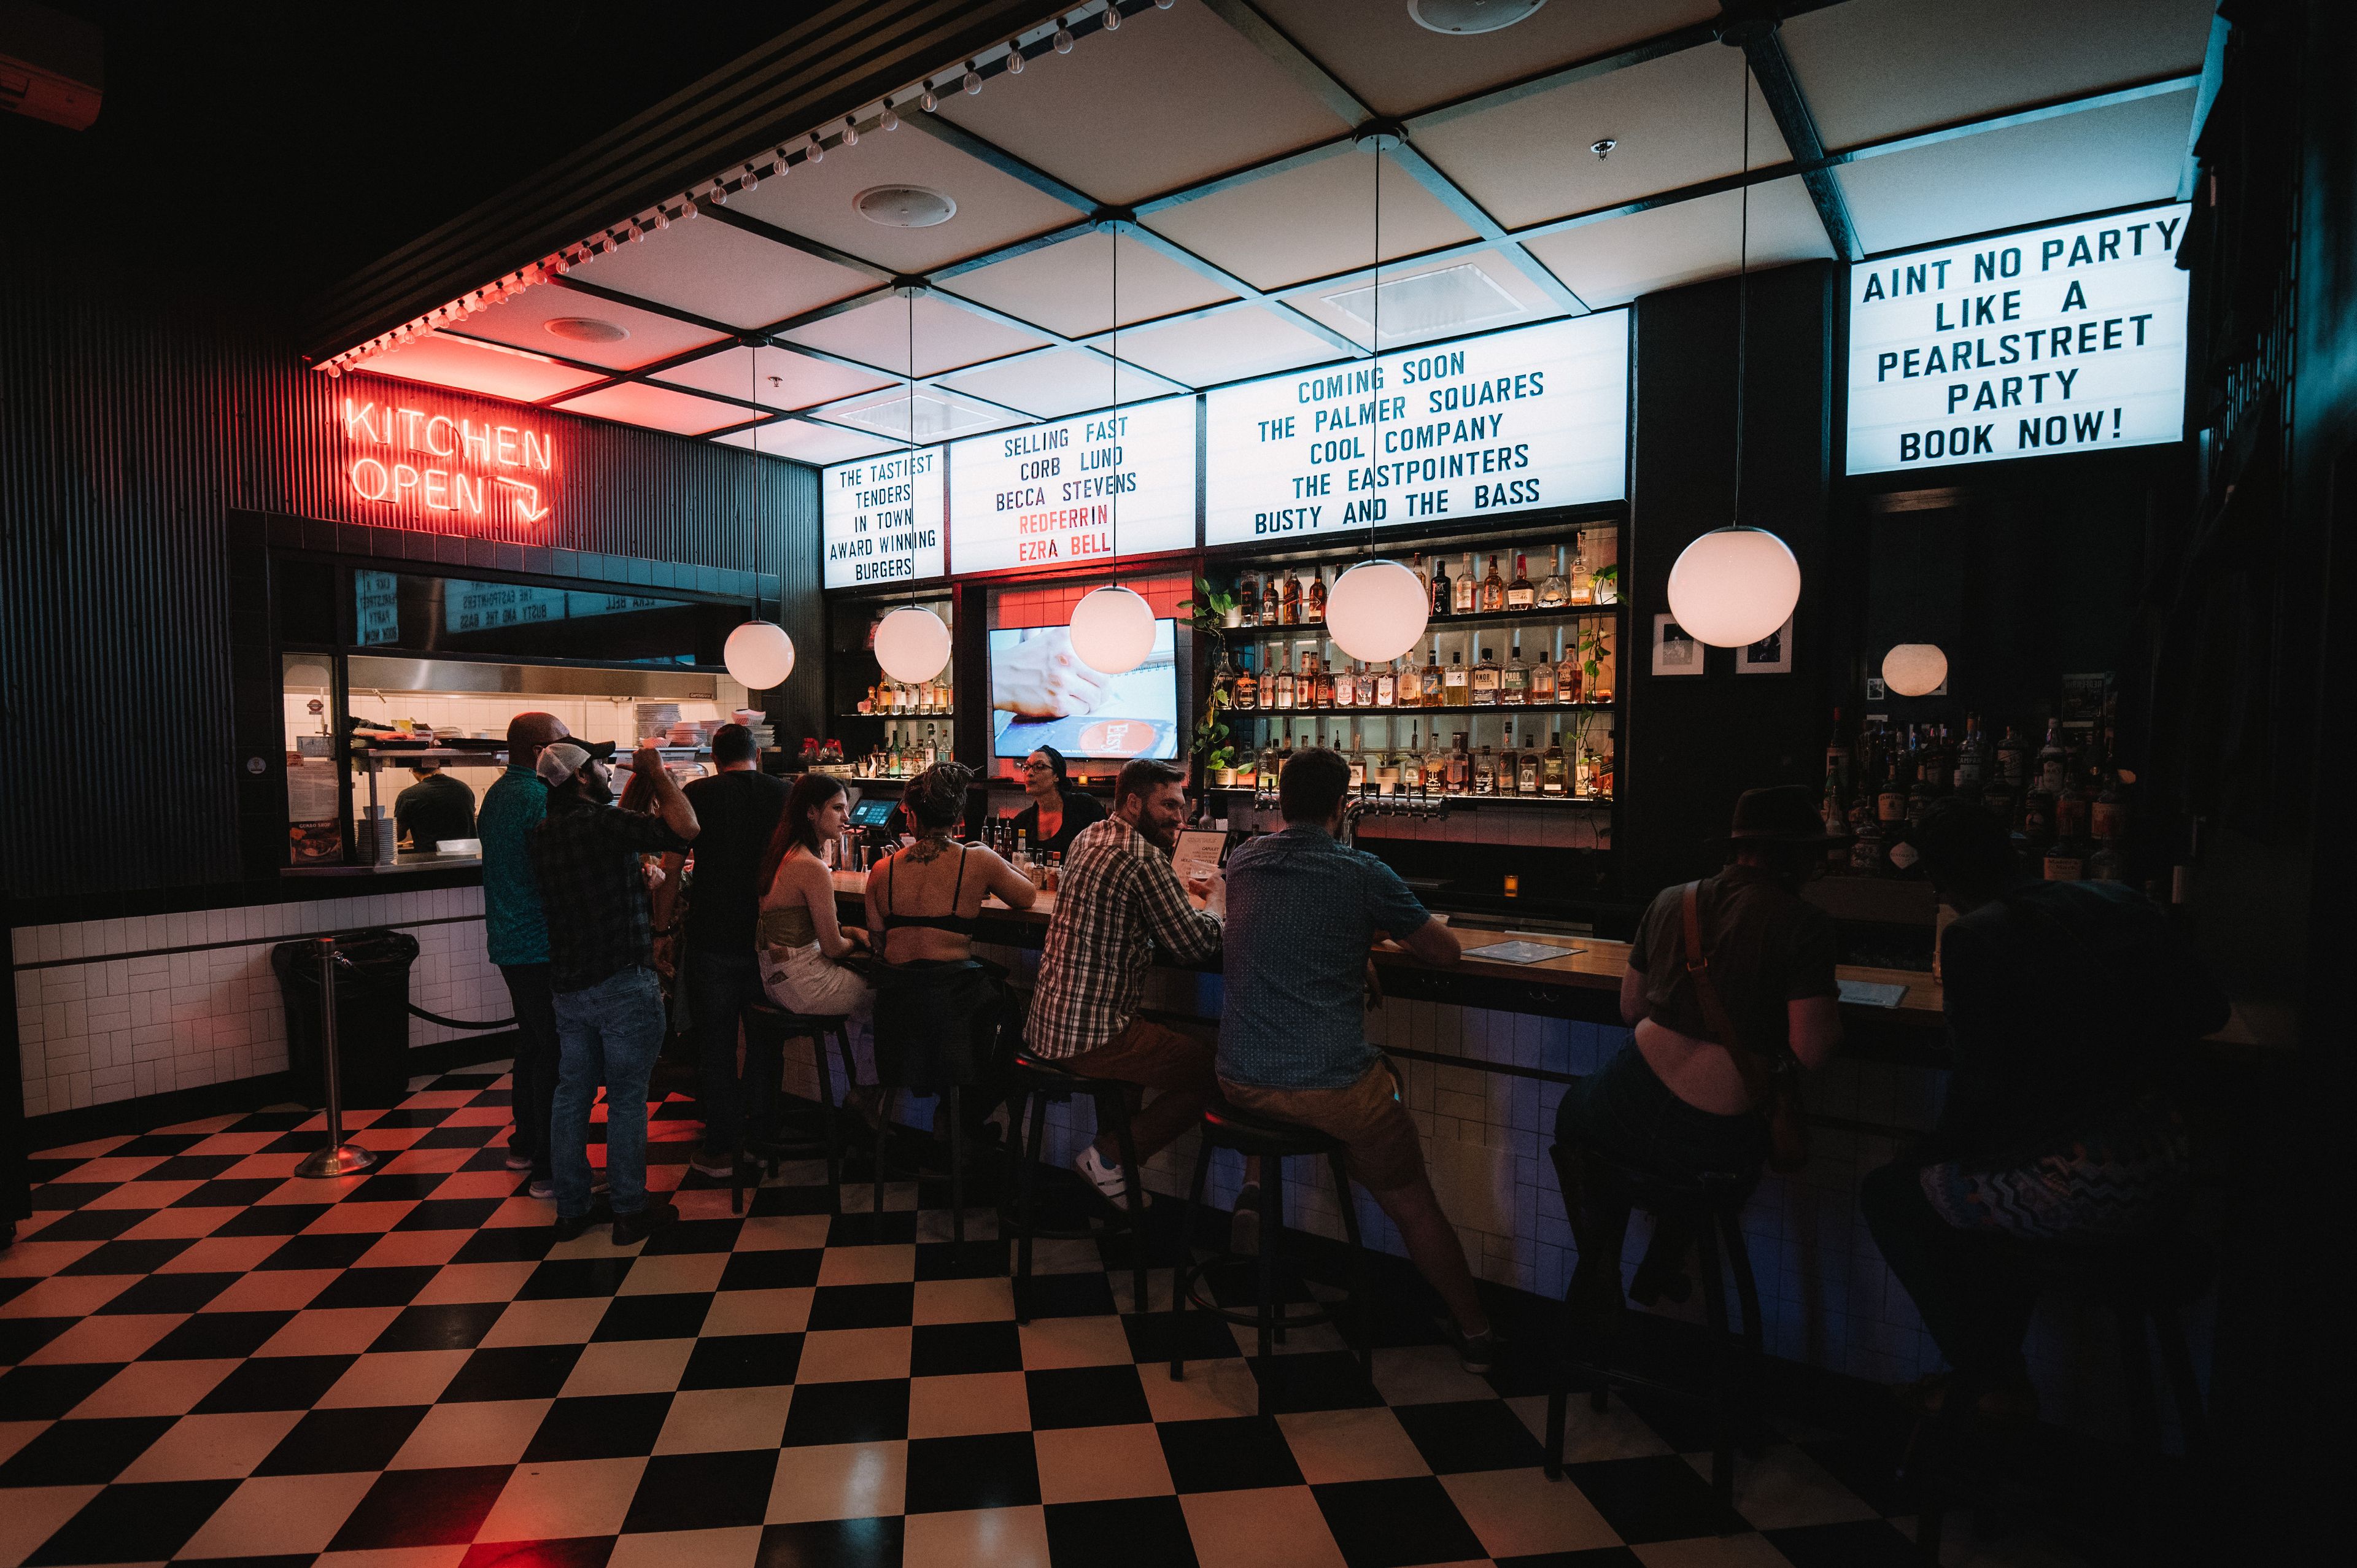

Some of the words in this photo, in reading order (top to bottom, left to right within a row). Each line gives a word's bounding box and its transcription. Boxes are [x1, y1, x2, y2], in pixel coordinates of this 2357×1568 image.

[1862, 258, 1951, 303] AINT
[1975, 248, 2021, 283] NO
[2042, 217, 2181, 271] PARTY
[1937, 290, 2020, 331] LIKE
[2061, 280, 2087, 312] A
[1878, 314, 2152, 382] PEARLSTREET
[1298, 366, 1384, 404] COMING
[1403, 350, 1463, 384] SOON
[1948, 368, 2079, 414] PARTY
[1258, 416, 1294, 442] THE
[1315, 396, 1406, 433] PALMER
[1429, 371, 1543, 414] SQUARES
[346, 398, 550, 470] KITCHEN
[1005, 428, 1067, 457] SELLING
[1086, 416, 1128, 442] FAST
[1311, 437, 1364, 464] COOL
[1386, 412, 1503, 454] COMPANY
[1900, 424, 1994, 462] BOOK
[2019, 408, 2122, 449] NOW!
[352, 458, 482, 514] OPEN
[840, 469, 861, 487] THE
[870, 454, 932, 482] TASTIEST
[1021, 458, 1059, 481] CORB
[1081, 446, 1122, 471] LUND
[1293, 473, 1329, 498] THE
[1349, 443, 1528, 492] EASTPOINTERS
[856, 484, 911, 509] TENDERS
[997, 487, 1045, 511] BECCA
[1063, 472, 1136, 501] STEVENS
[1256, 506, 1322, 535] BUSTY
[1343, 498, 1387, 525] AND
[1406, 490, 1449, 517] THE
[1475, 479, 1540, 509] BASS
[856, 516, 866, 532] IN
[877, 508, 912, 528] TOWN
[1020, 504, 1107, 534] REDFERRIN
[830, 539, 872, 560] AWARD
[880, 529, 935, 552] WINNING
[1020, 539, 1059, 562] EZRA
[1072, 533, 1111, 555] BELL
[856, 559, 912, 581] BURGERS
[1101, 725, 1128, 751] Etsy
